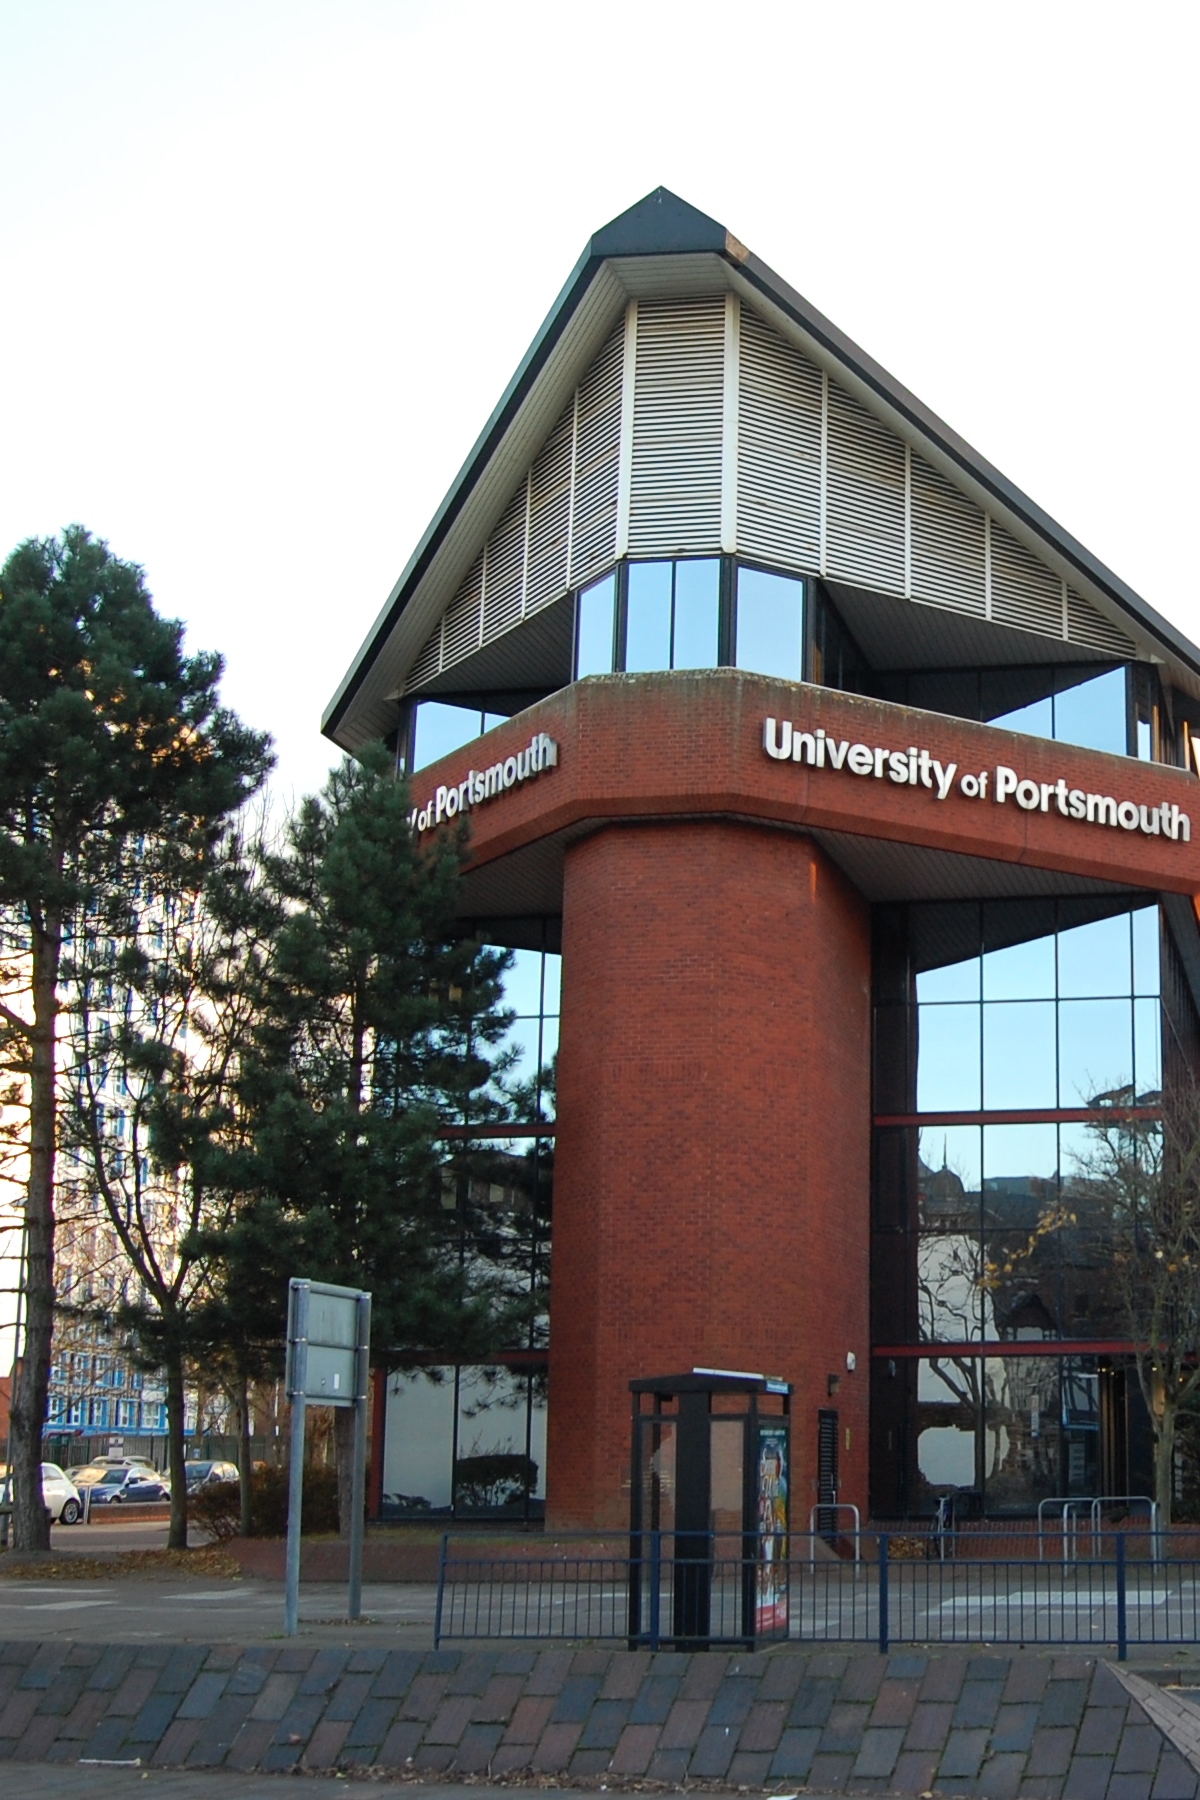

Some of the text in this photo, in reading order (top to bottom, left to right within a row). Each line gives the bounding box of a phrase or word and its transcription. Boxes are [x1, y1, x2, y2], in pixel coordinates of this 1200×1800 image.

[418, 800, 433, 832] of
[436, 733, 557, 823] Portsmouth
[763, 717, 1190, 842] University of Portsmouth
